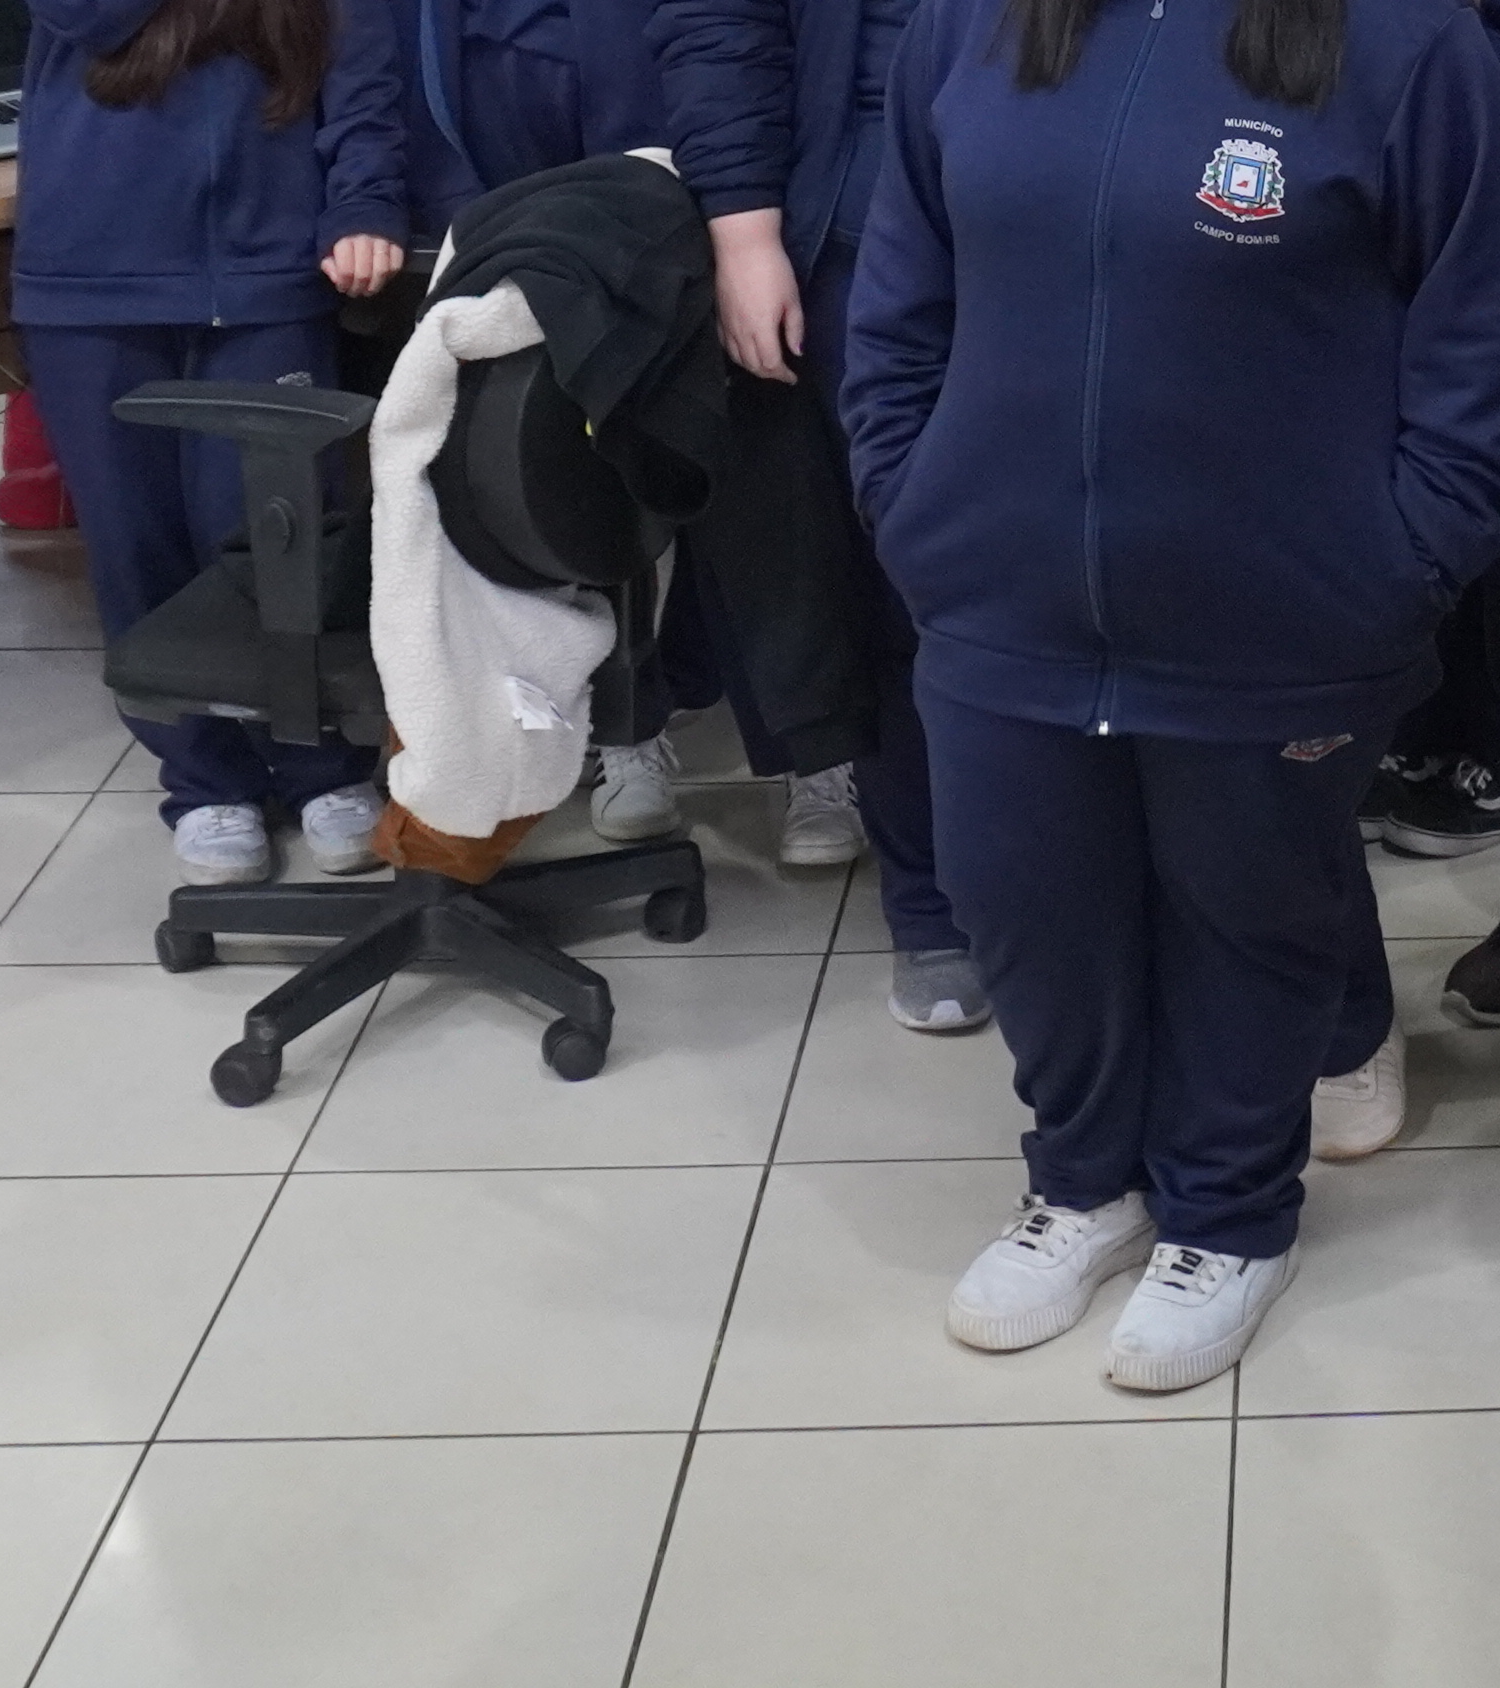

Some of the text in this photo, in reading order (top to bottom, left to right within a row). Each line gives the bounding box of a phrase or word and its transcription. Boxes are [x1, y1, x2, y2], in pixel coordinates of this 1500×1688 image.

[1224, 118, 1284, 138] MUNICÍPIO
[1194, 221, 1280, 245] CAMPO BOM/RS
